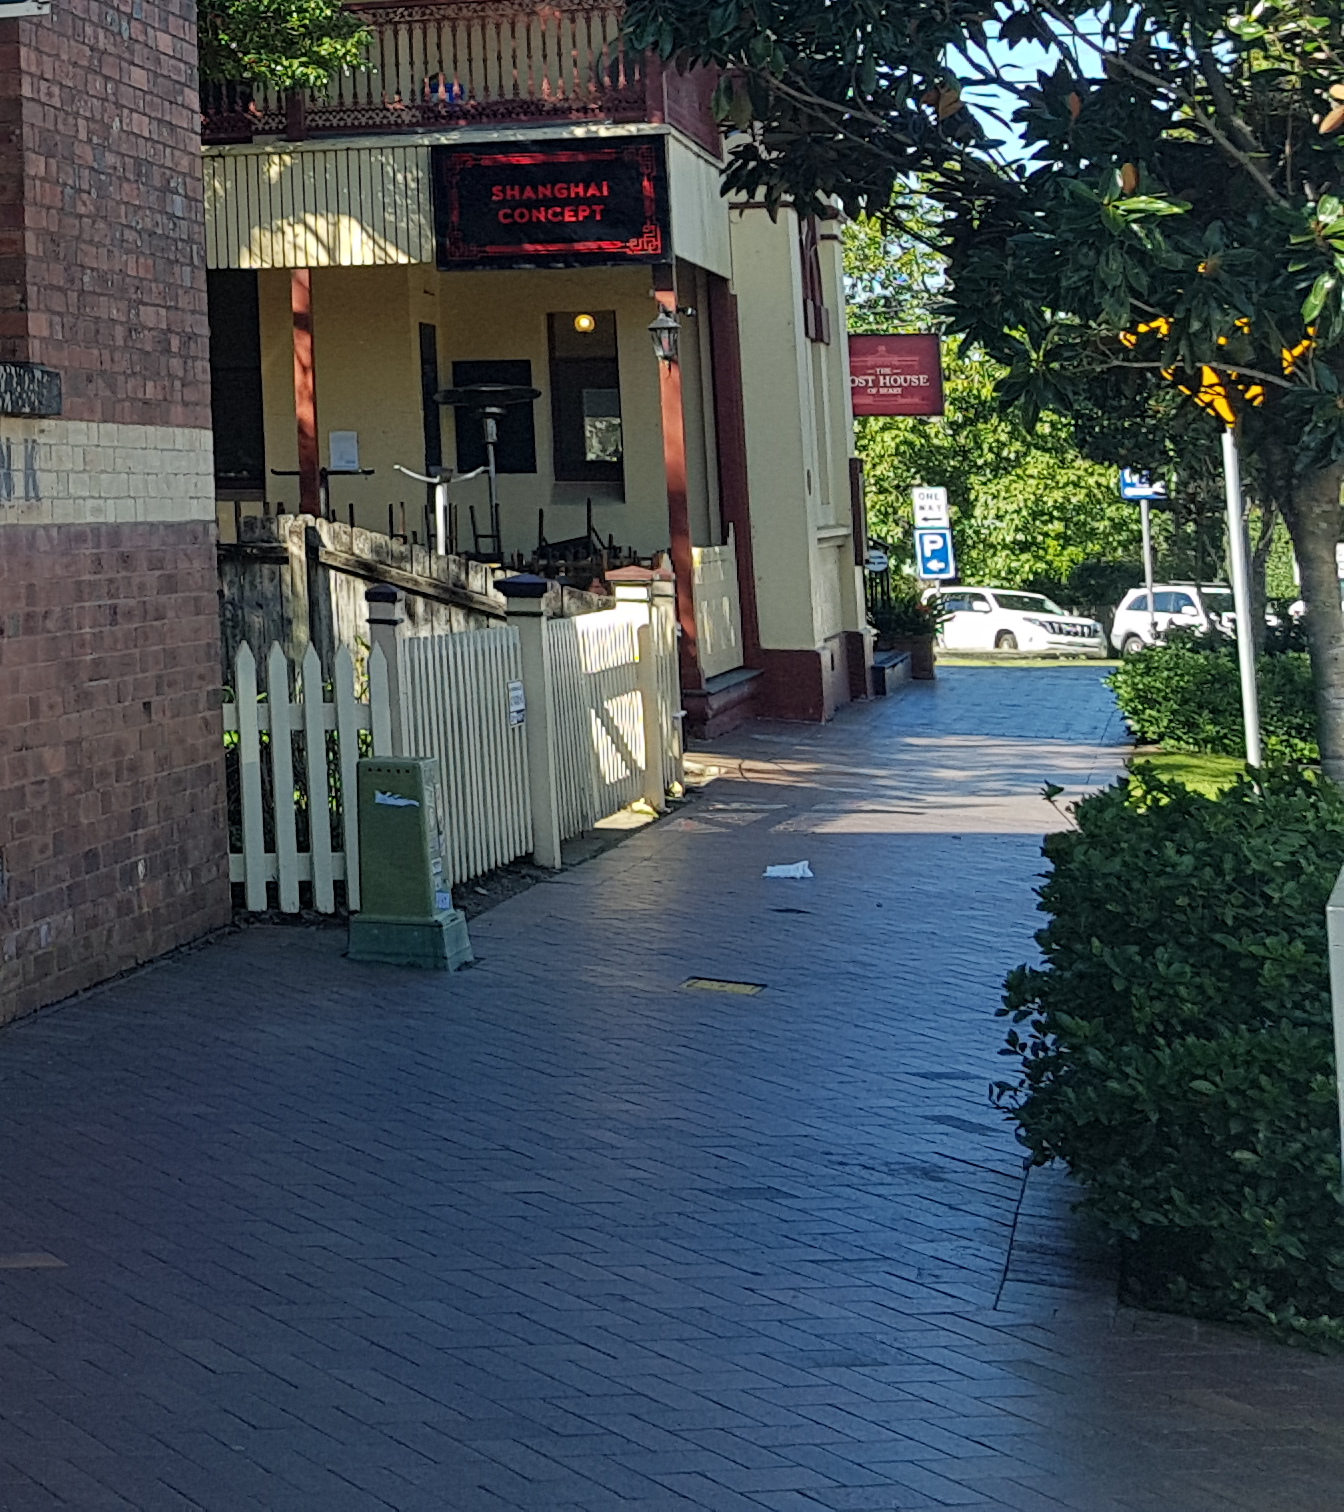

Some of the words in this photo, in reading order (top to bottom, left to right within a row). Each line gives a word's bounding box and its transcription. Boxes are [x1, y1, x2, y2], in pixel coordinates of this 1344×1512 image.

[491, 181, 610, 201] SHANGHAI
[498, 205, 605, 224] CONCEPT
[850, 375, 876, 387] OST
[879, 375, 930, 386] HOUSE
[918, 493, 940, 501] ONE
[922, 534, 944, 558] P
